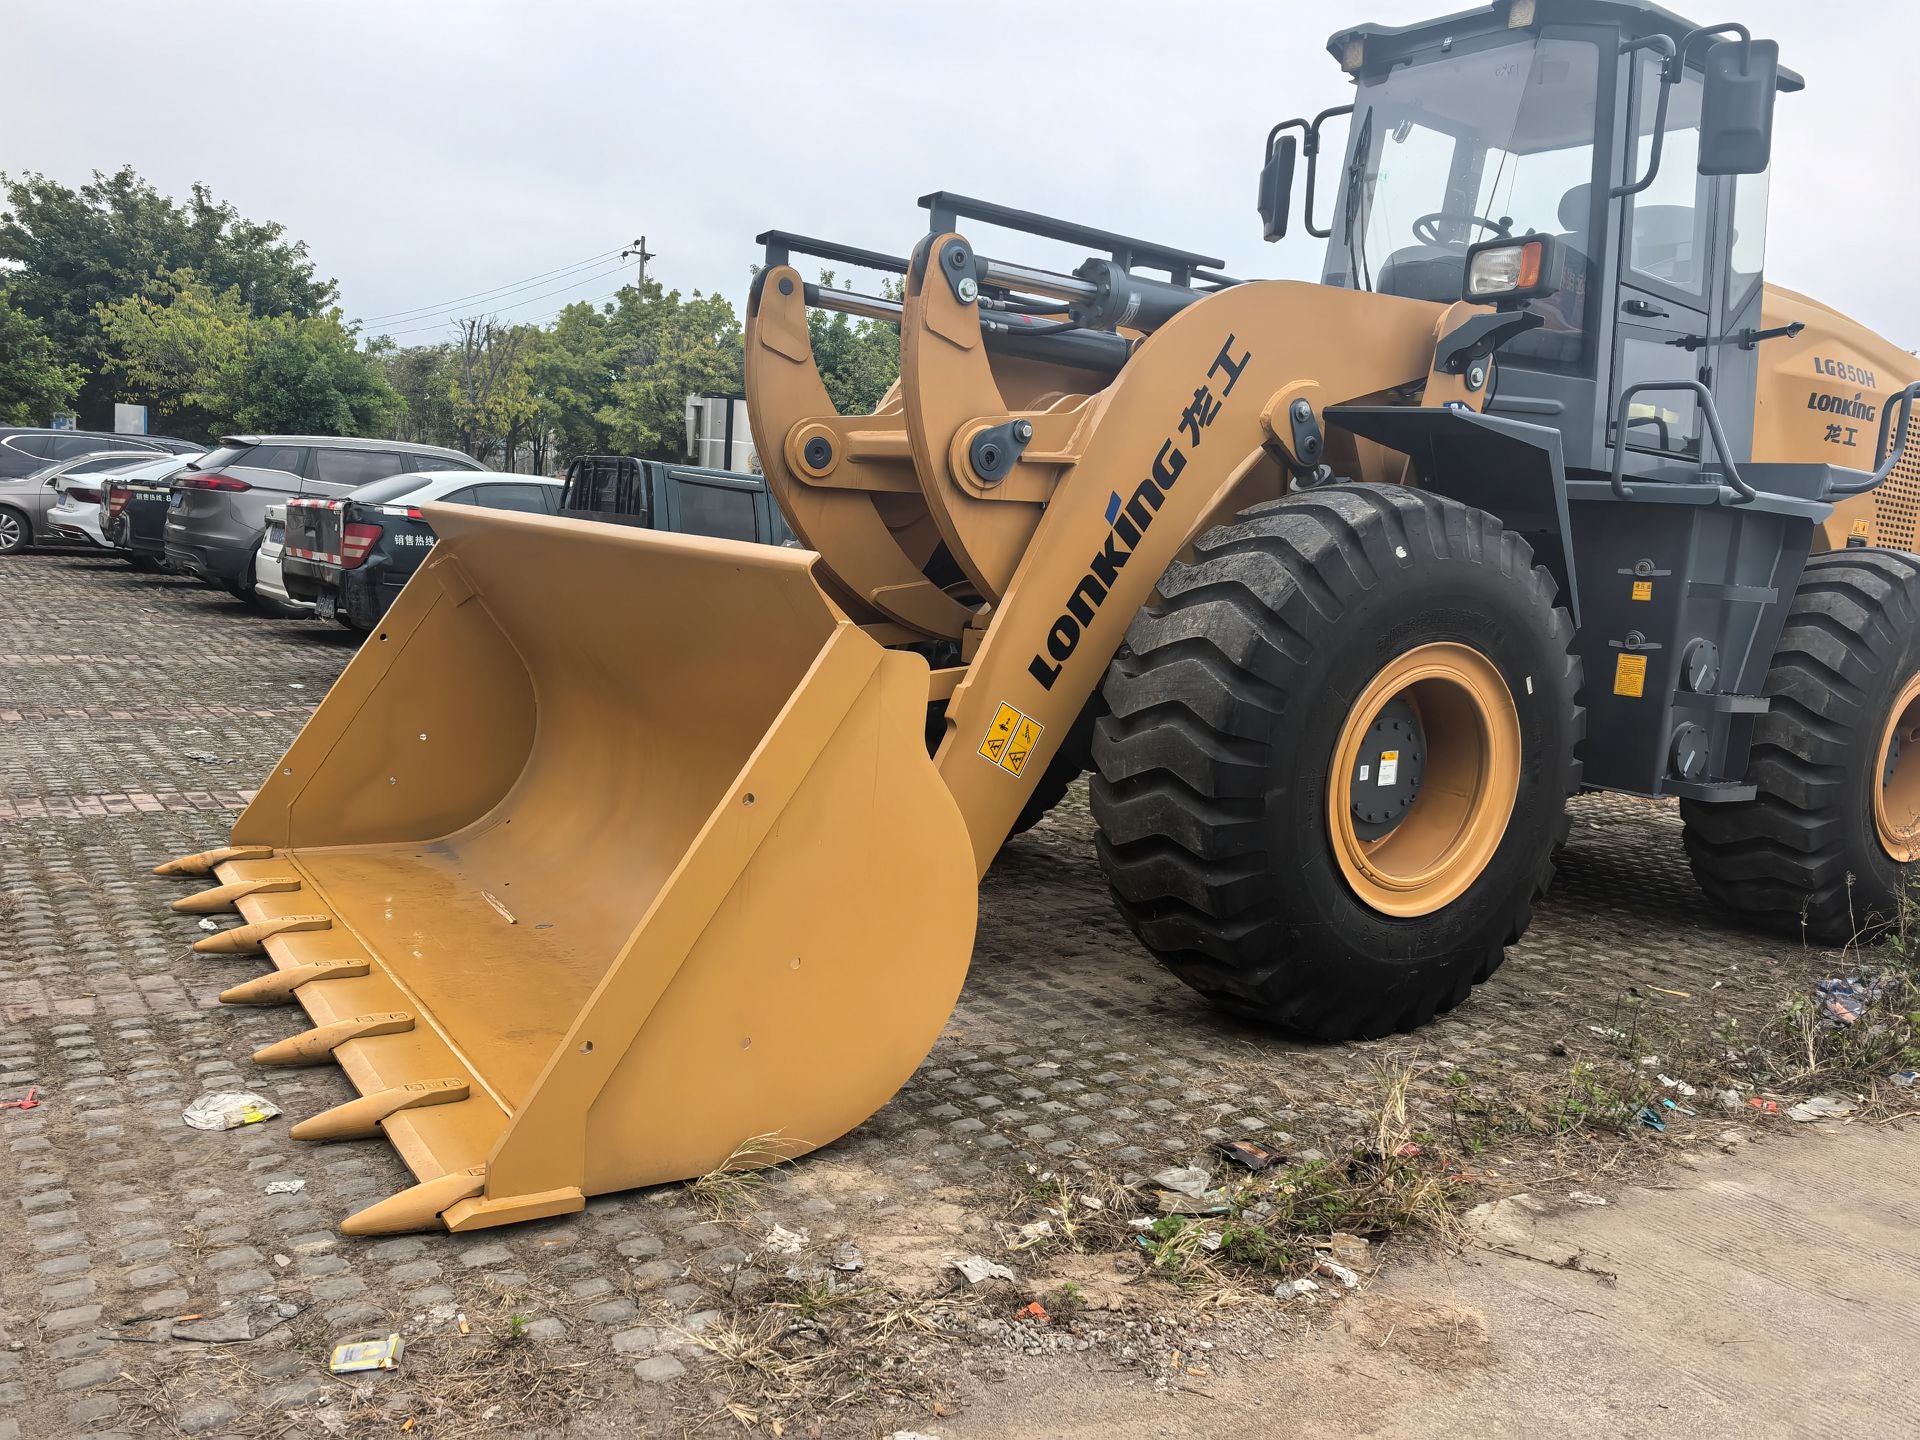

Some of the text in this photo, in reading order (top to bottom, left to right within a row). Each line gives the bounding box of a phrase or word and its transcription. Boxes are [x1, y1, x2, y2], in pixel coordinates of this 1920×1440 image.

[1814, 356, 1877, 389] LG850H
[1177, 332, 1252, 448] 龙工
[1823, 423, 1859, 447] 龙工
[394, 534, 435, 547] 销售热线
